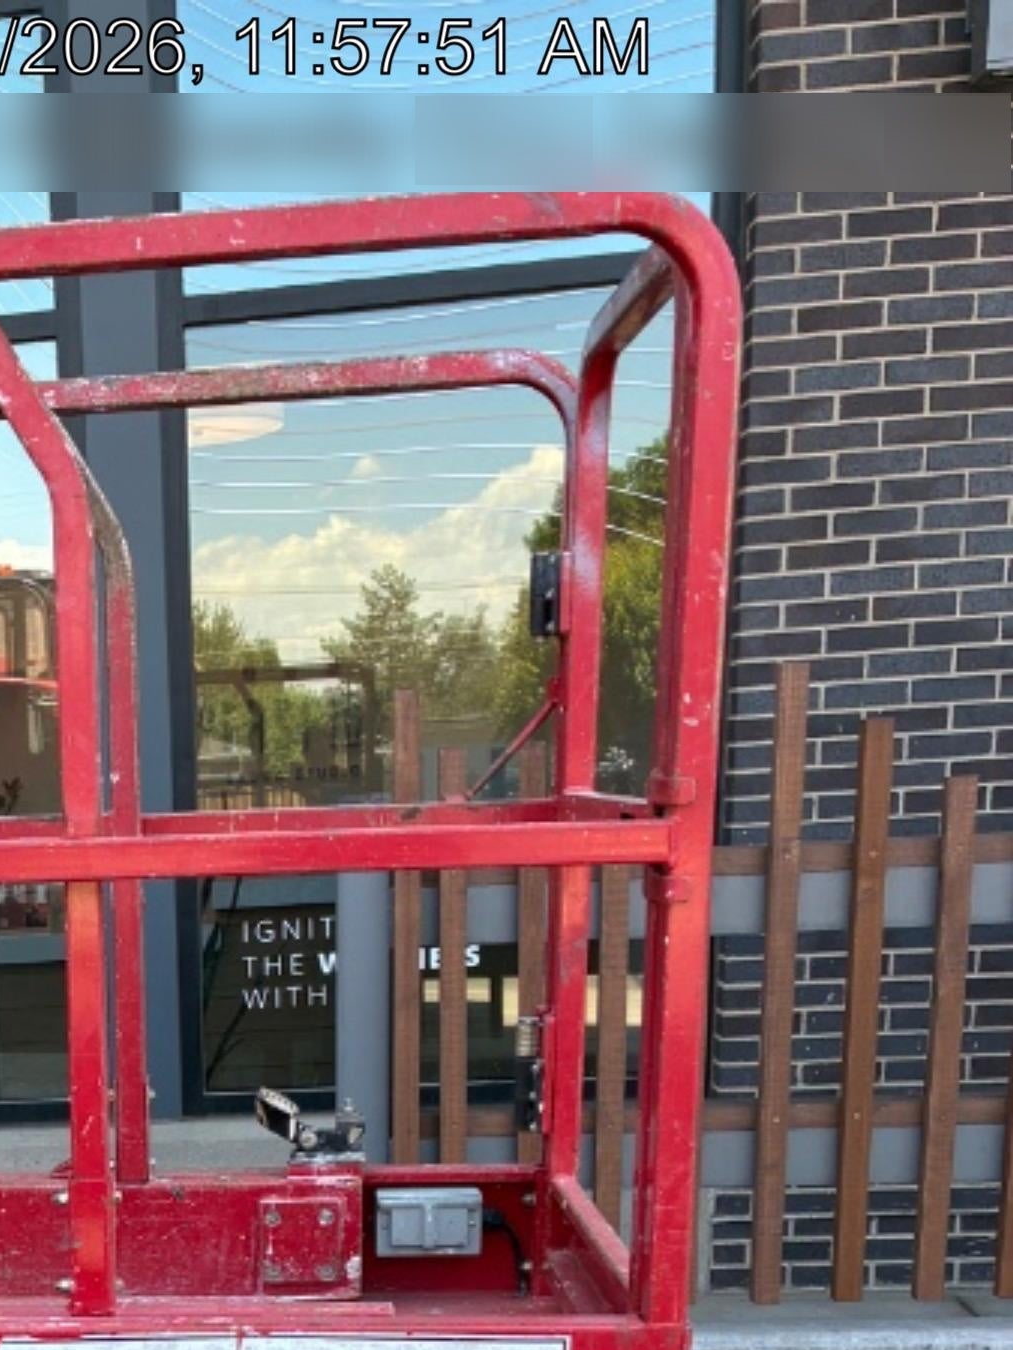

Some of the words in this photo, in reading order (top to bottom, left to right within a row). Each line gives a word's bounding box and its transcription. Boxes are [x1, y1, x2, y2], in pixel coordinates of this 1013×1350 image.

[242, 916, 336, 943] IGNIT
[242, 952, 305, 979] THE
[242, 983, 327, 1010] WITH
